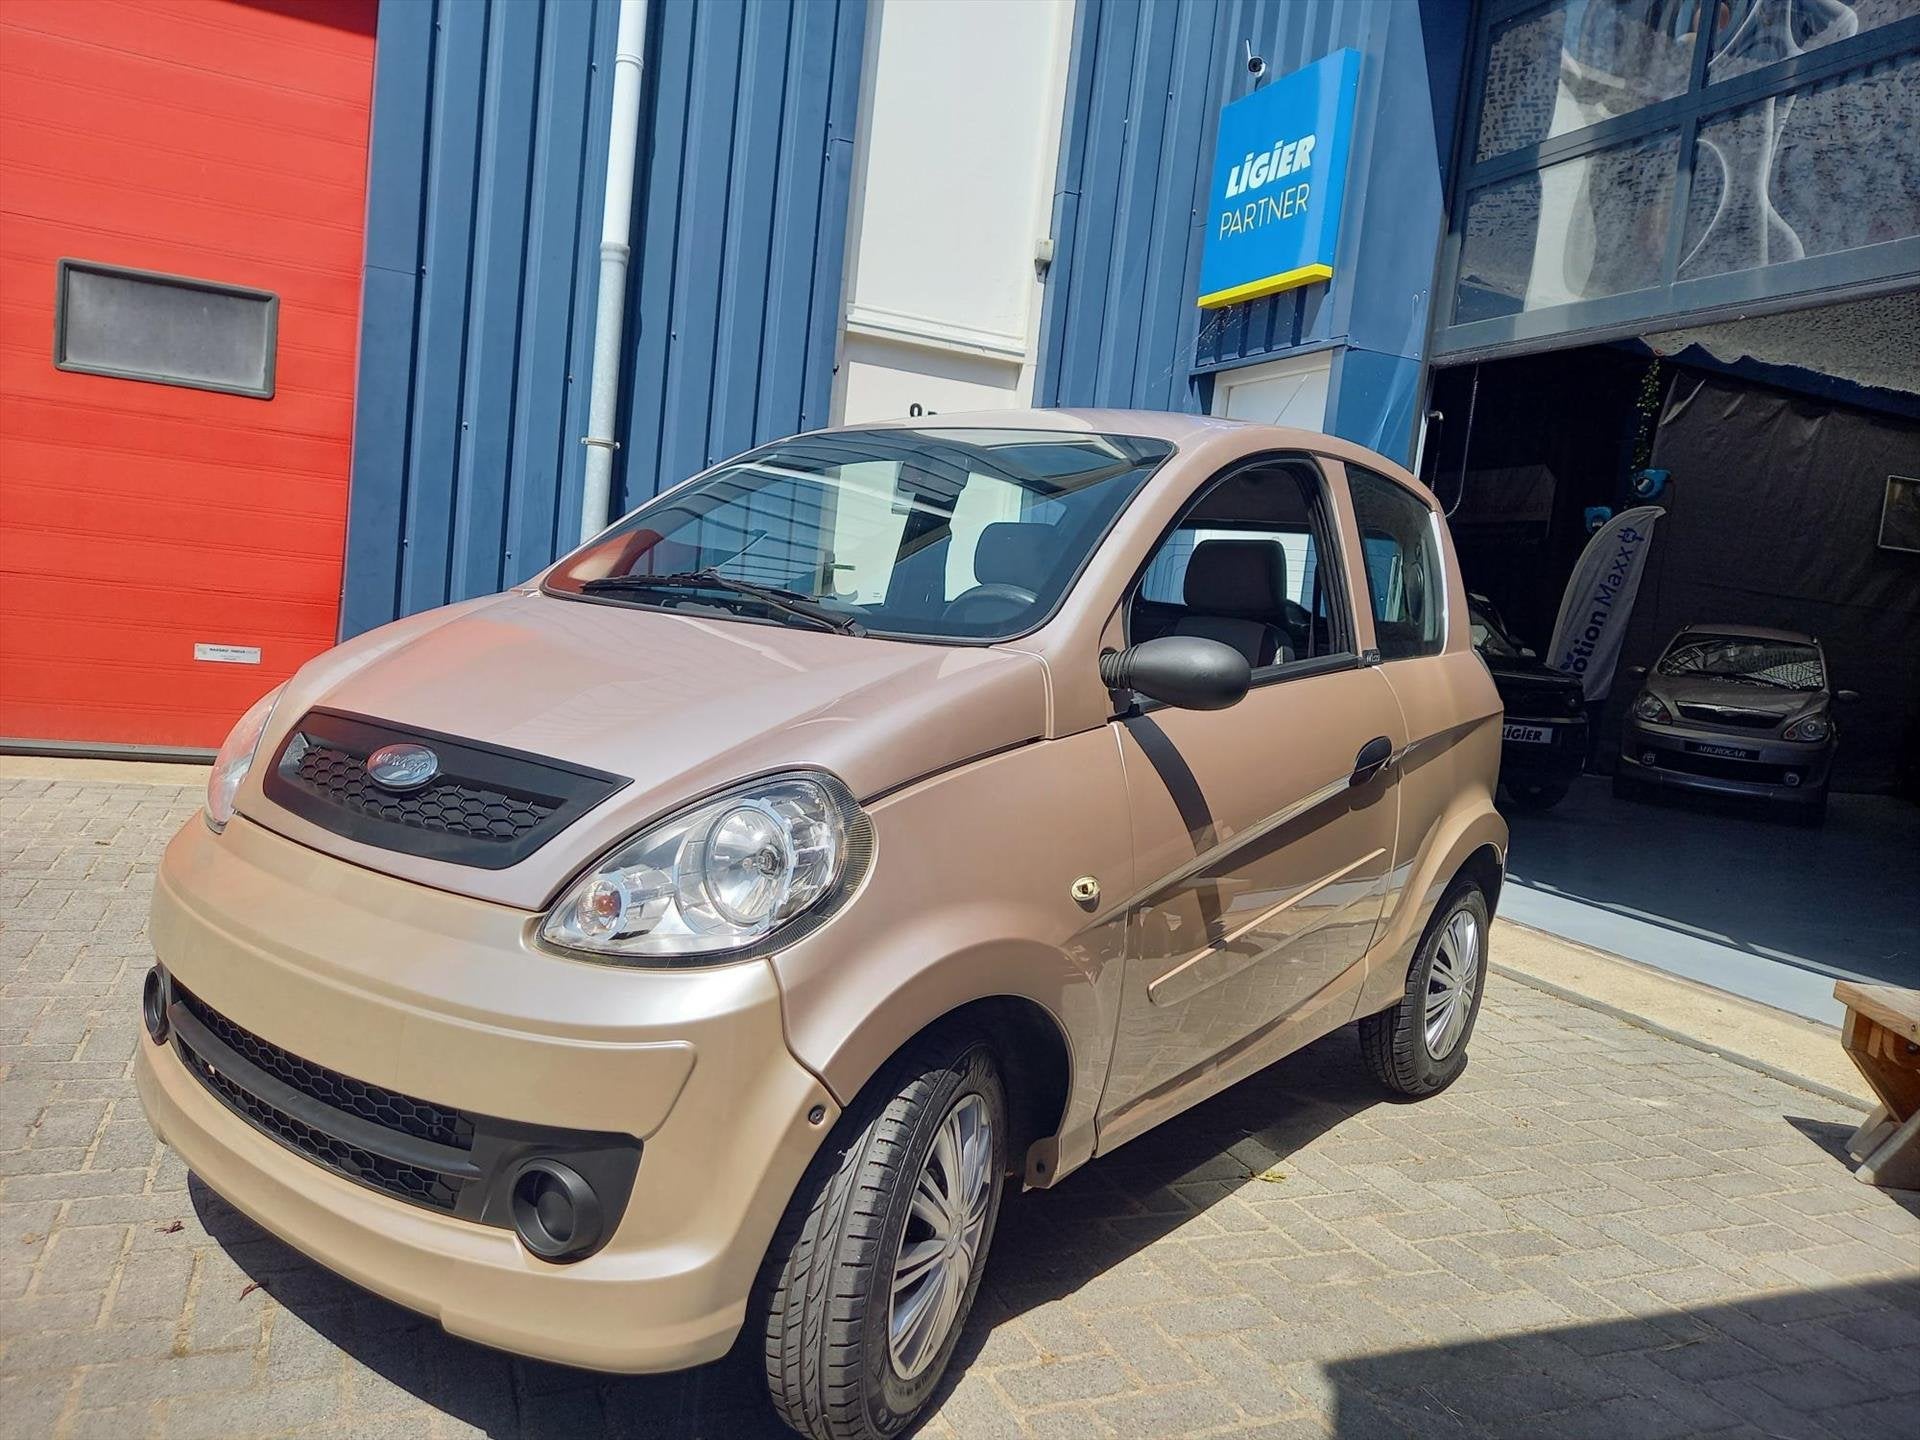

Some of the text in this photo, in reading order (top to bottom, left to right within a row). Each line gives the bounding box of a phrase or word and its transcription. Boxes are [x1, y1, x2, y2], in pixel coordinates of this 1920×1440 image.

[1219, 183, 1310, 241] PARTNER
[1572, 546, 1633, 679] otion Maxx
